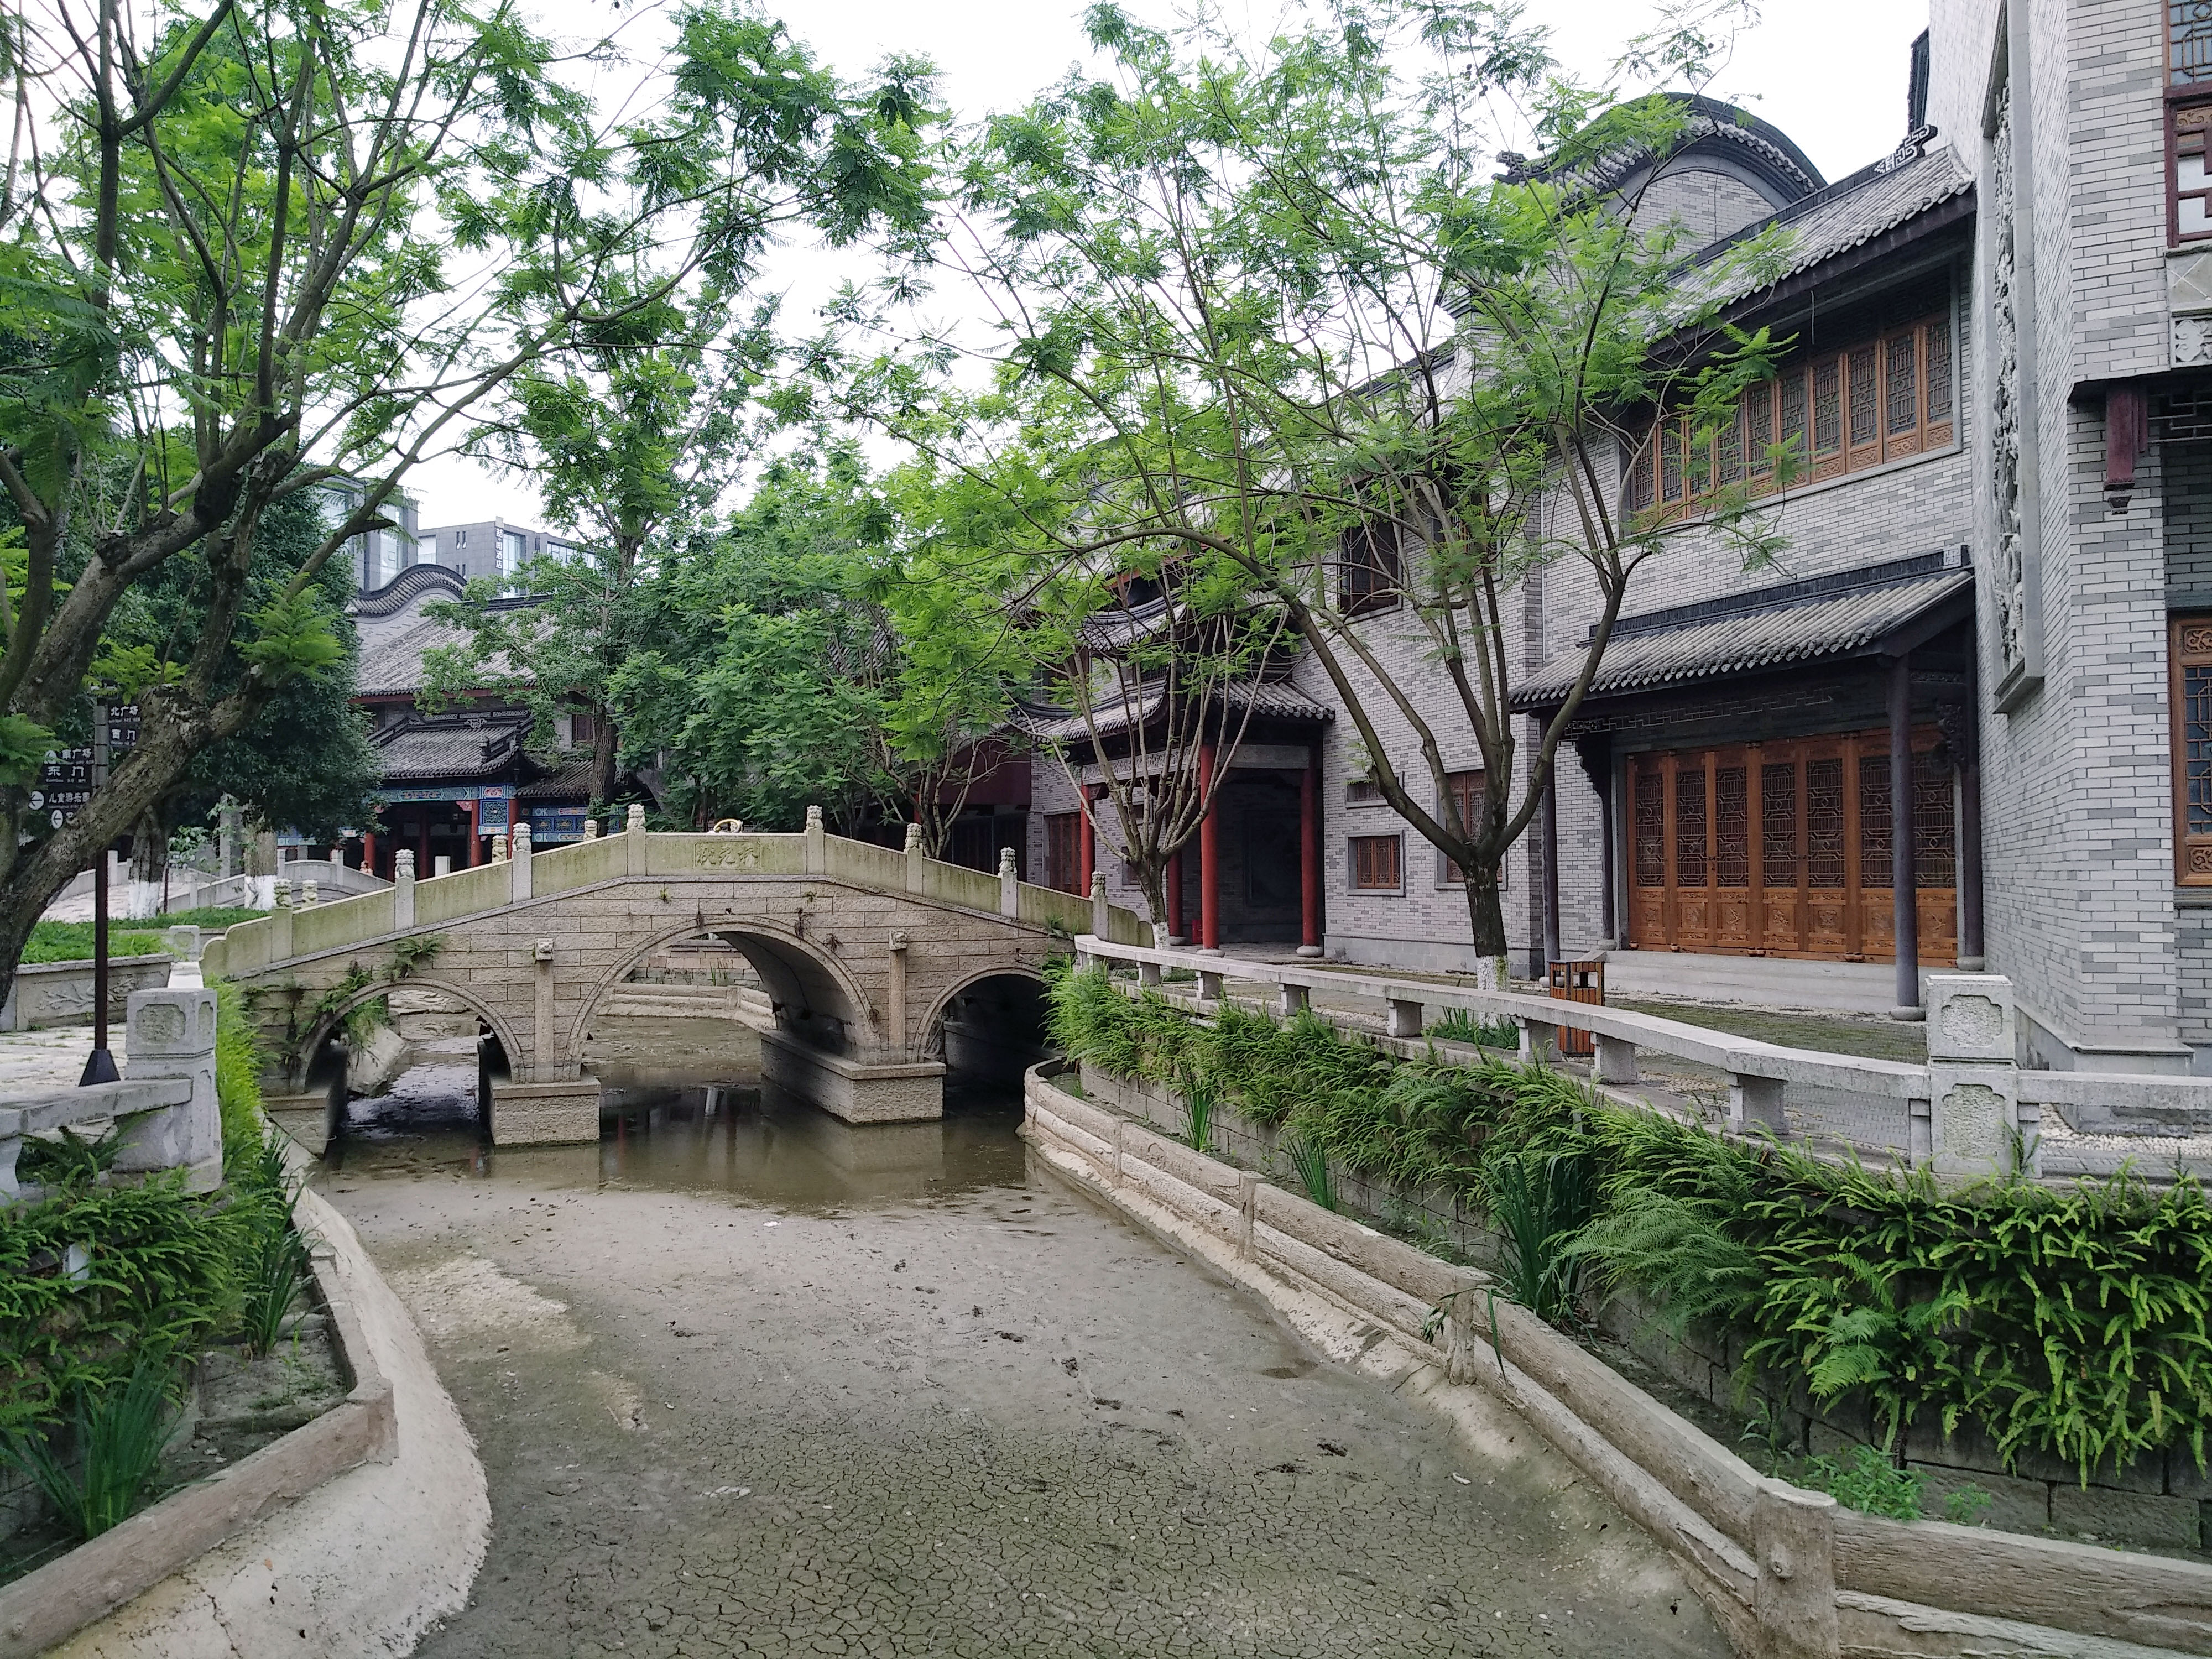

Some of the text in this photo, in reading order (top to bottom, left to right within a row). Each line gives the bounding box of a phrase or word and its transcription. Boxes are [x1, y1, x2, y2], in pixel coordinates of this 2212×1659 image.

[111, 706, 138, 717] 北广场
[62, 748, 92, 759] 南广场
[48, 766, 84, 777] 东门
[49, 792, 90, 803] 儿童游乐园
